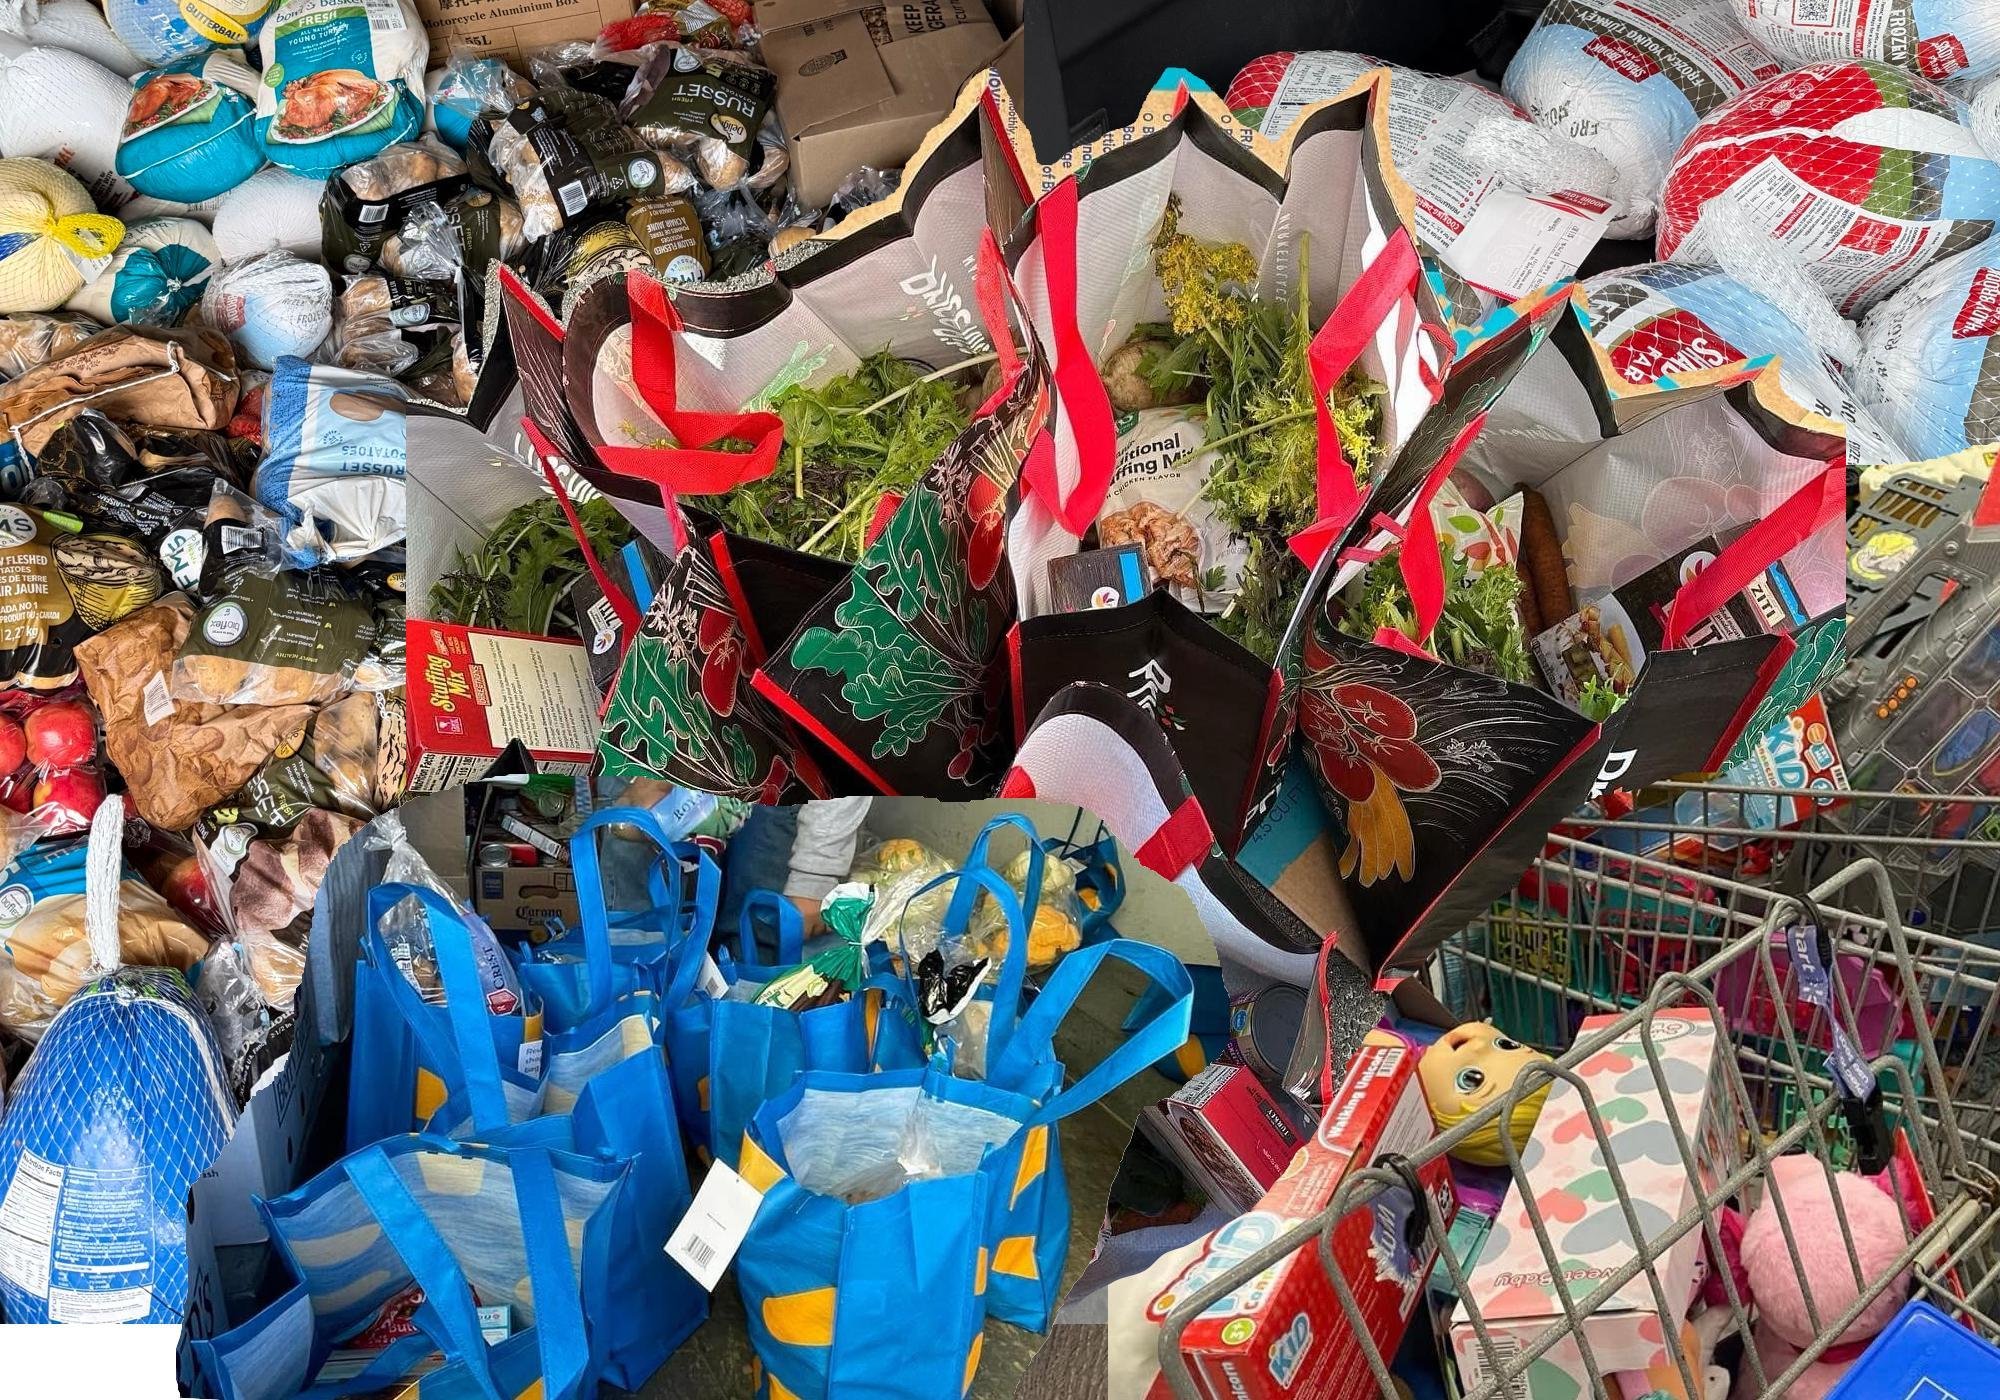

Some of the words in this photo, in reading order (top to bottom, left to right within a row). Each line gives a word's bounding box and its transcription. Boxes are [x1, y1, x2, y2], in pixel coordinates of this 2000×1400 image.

[186, 3, 242, 41] BUTTERBALL
[299, 10, 336, 27] FRESH
[425, 10, 487, 29] Motorcycle
[489, 2, 553, 19] Aluminium
[903, 4, 924, 33] KEEP
[289, 34, 316, 46] YOUNG
[1626, 30, 1664, 56] YOUNG
[1890, 9, 1907, 61] FROZEN
[1663, 53, 1705, 87] FROZEN
[673, 84, 755, 118] RUSSET
[1042, 166, 1051, 179] of
[653, 242, 678, 255] FLESHED
[341, 445, 406, 460] POTATOES
[340, 462, 405, 475] RUSSET
[1114, 476, 1145, 497] CHICKEN
[6, 555, 48, 566] FLESHED
[167, 535, 199, 589] FMS
[8, 575, 20, 583] DE
[23, 575, 48, 583] TERRE
[15, 584, 49, 595] JAUNE
[20, 602, 31, 611] NO
[1751, 584, 1776, 618] ZITI
[26, 626, 39, 640] kg
[210, 619, 240, 631] bioflex
[425, 654, 455, 712] Stuffing
[447, 670, 471, 699] Mix
[278, 794, 294, 816] FRESH
[516, 905, 562, 920] Corona
[1327, 1091, 1367, 1139] Walking
[1355, 1048, 1389, 1090] Unicorn
[1268, 1109, 1290, 1137] TURKEY
[1493, 1270, 1552, 1288] Baby
[1564, 1266, 1620, 1282] weet
[1270, 1314, 1310, 1385] KID
